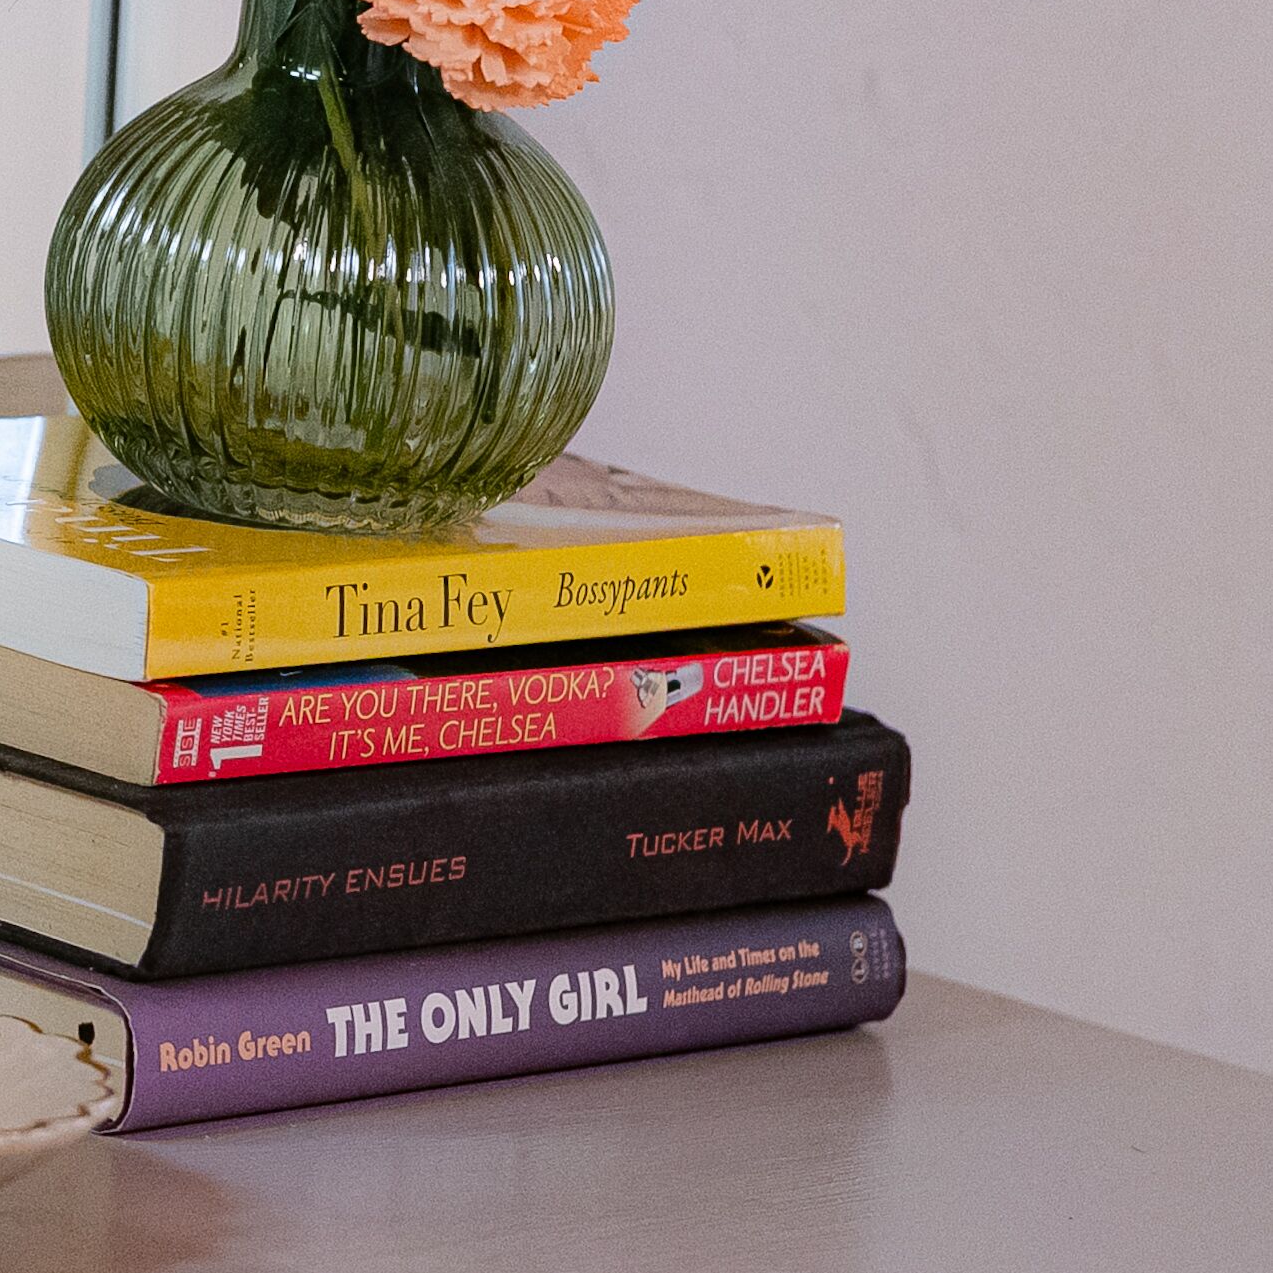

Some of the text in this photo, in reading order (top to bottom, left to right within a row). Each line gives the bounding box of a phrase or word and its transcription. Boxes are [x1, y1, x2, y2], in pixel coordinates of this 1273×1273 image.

[326, 573, 513, 643] Tina Fey
[554, 569, 688, 616] Bossypants
[232, 594, 243, 660] National
[245, 589, 256, 662] Bestseller
[713, 650, 826, 688] CHELSEA
[279, 667, 615, 726] ARE YOU THERE, VODKA?
[705, 686, 826, 726] HANDLER
[210, 715, 223, 744] NEW
[221, 710, 235, 741] YORK
[232, 705, 247, 741] TIMES
[243, 708, 257, 742] BEST-
[254, 696, 270, 741] SELLER
[329, 712, 557, 761] IT'S ME, CHELSEA
[626, 819, 793, 858] TUCKER MAX
[202, 856, 466, 911] HILARITY ENSUES
[661, 939, 820, 982] My Life and Times on the
[663, 969, 829, 1008] Masthead of Rolling Stone
[326, 965, 648, 1058] THE ONLY GIRL
[159, 1030, 312, 1072] Robin Green
